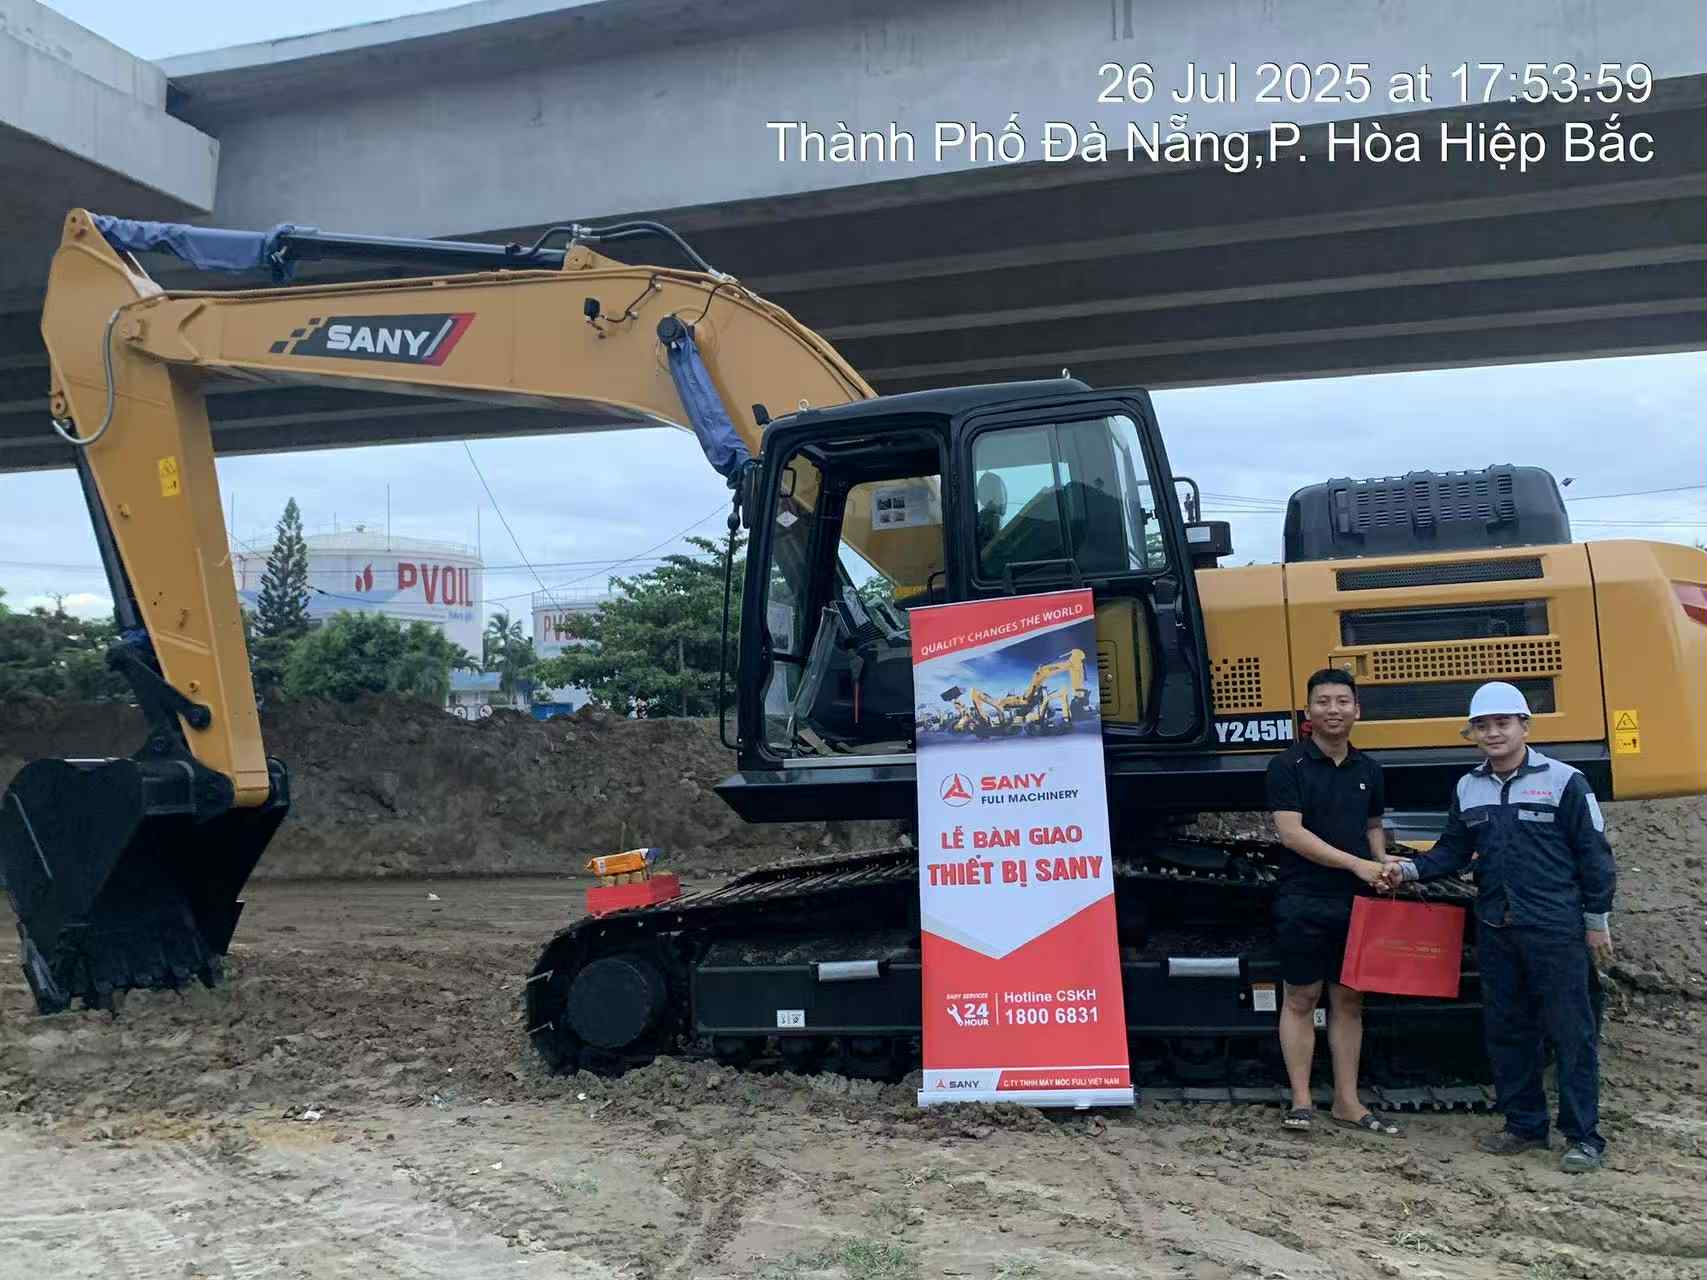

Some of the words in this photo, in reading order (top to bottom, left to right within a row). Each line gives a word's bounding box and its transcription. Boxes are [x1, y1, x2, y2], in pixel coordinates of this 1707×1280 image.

[326, 325, 430, 355] SANY
[397, 563, 473, 607] PVOIL
[921, 634, 965, 656] QUALITY
[967, 621, 1018, 643] CHANGES
[1019, 613, 1041, 629] THE
[1042, 604, 1084, 623] WORLD
[980, 773, 1046, 791] SANY
[981, 794, 1004, 805] FULI
[1008, 789, 1079, 804] MACHINERY
[941, 826, 965, 849] LỄ
[973, 827, 1020, 849] BÀN
[1029, 825, 1083, 846] GIAO
[928, 855, 993, 886] THIẾT
[1002, 860, 1028, 887] BỊ
[1035, 856, 1103, 881] SANY
[1004, 991, 1052, 1003] Hotline
[1056, 989, 1096, 1002] CSKH
[964, 1003, 989, 1018] 24
[1005, 1008, 1049, 1025] 1800
[1055, 1006, 1098, 1023] 6831
[949, 1080, 979, 1089] SANY
